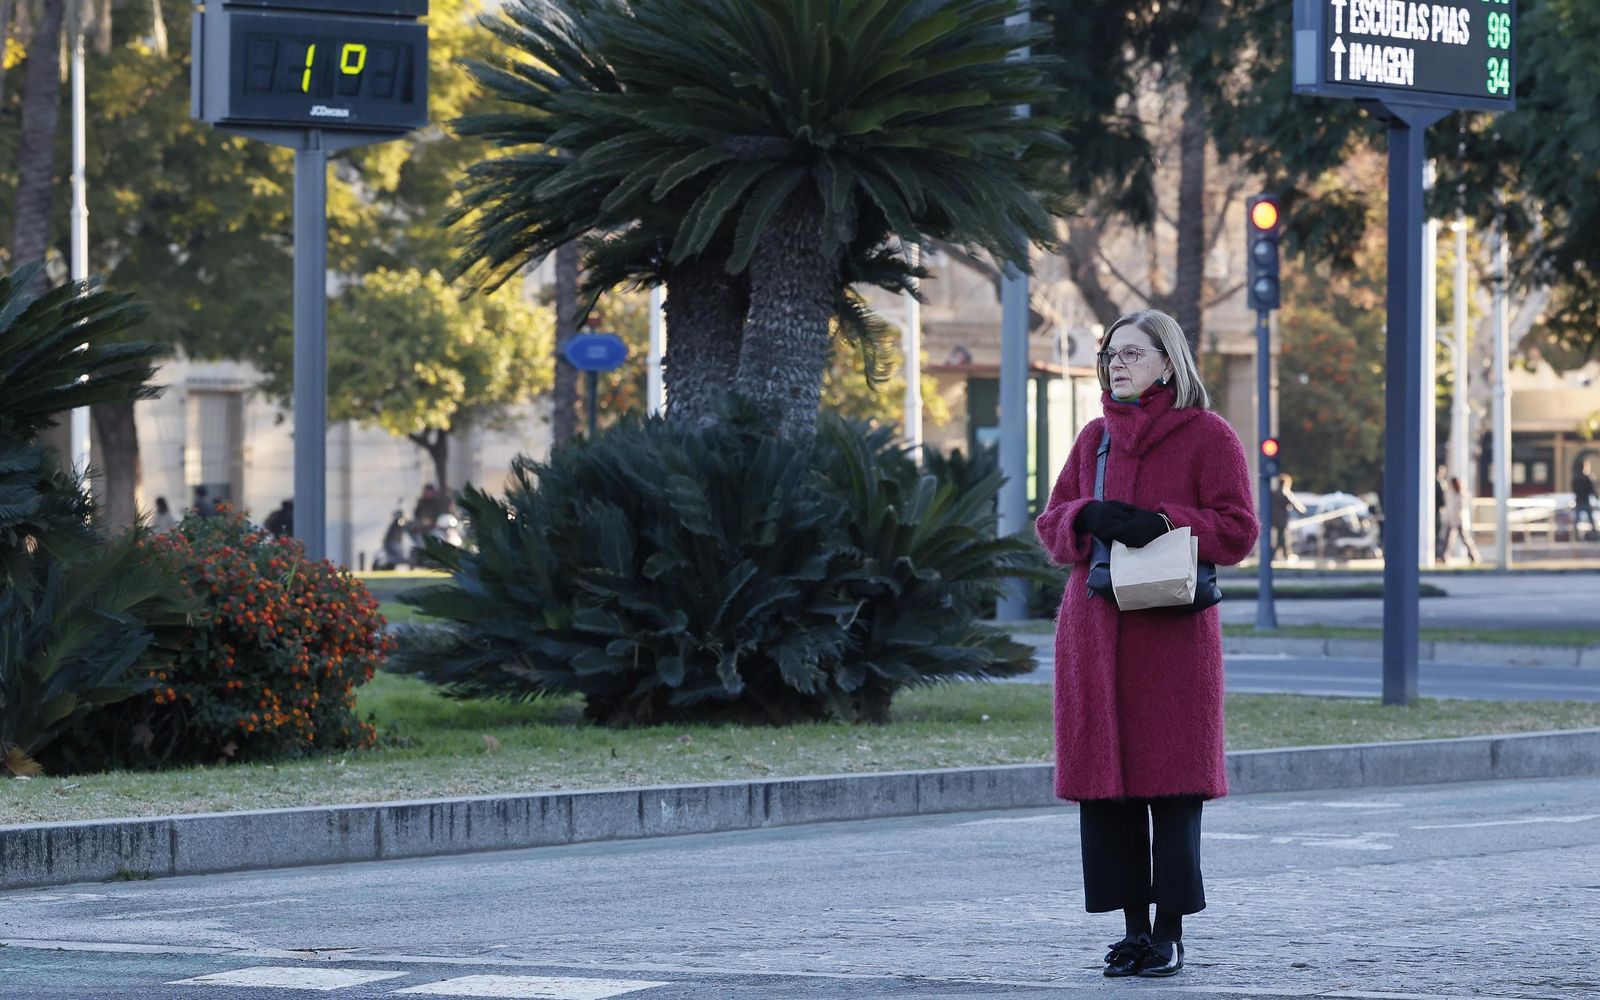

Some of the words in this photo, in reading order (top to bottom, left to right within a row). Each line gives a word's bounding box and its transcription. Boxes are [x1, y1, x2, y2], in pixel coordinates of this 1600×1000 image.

[1349, 0, 1430, 41] ESCUELAS
[1431, 4, 1470, 45] PIAS
[1487, 11, 1511, 50] 96
[1349, 41, 1415, 86] IMAGEN
[1486, 56, 1511, 95] 34
